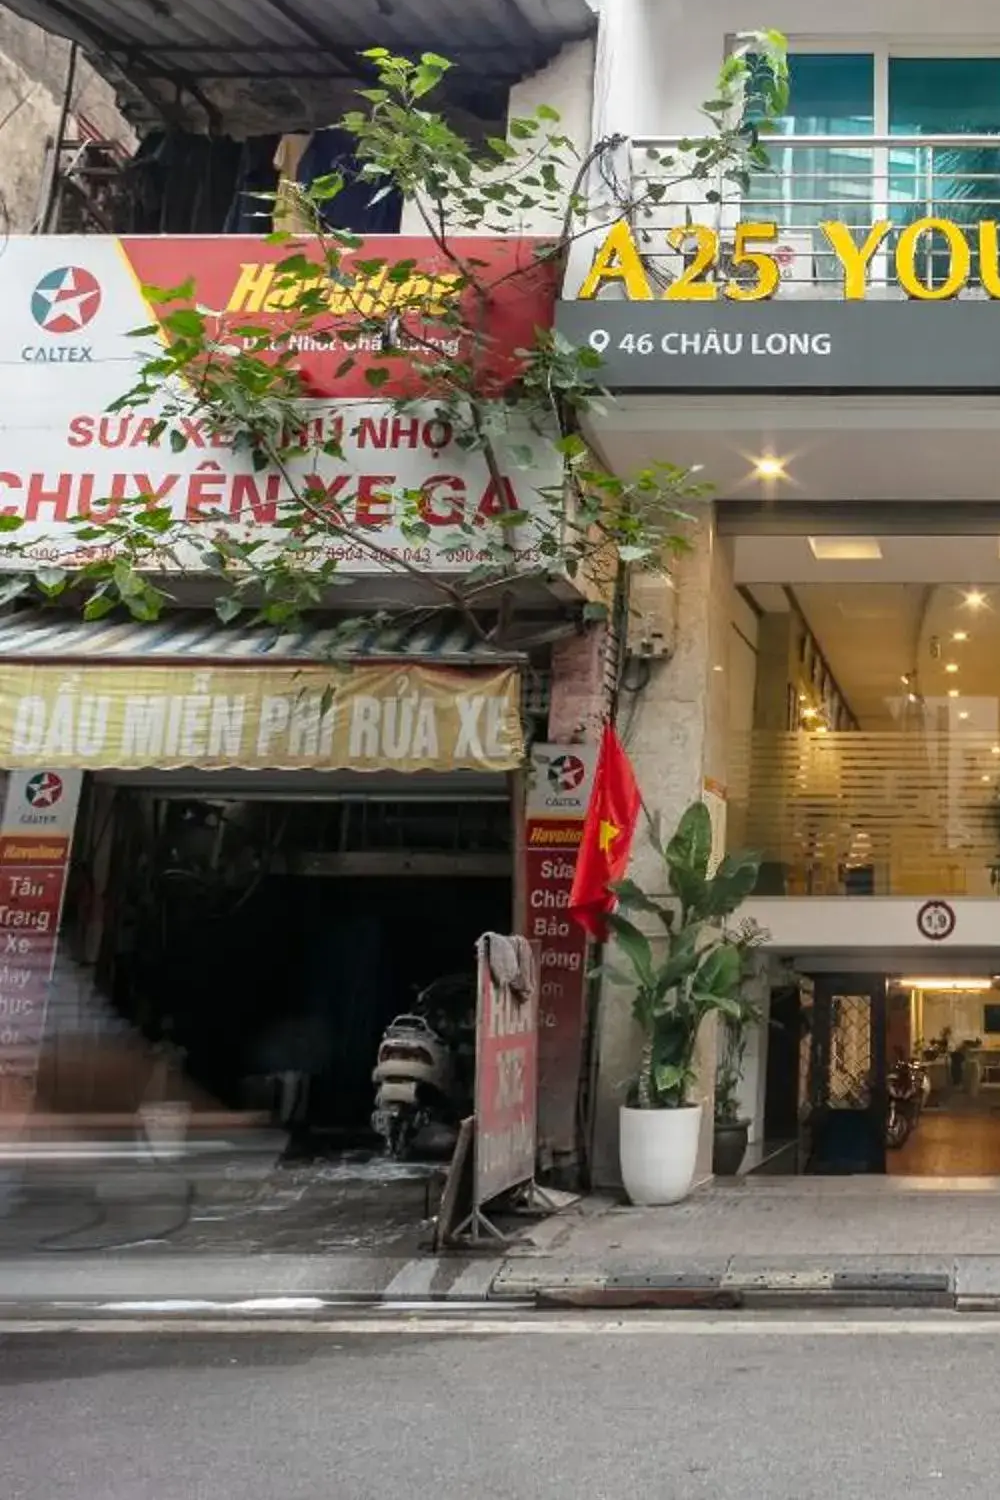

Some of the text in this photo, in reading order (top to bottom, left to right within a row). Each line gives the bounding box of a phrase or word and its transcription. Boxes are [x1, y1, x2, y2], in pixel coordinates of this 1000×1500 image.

[618, 327, 832, 355] 46 CHÂU LONG
[21, 345, 93, 363] CALTEX
[302, 474, 397, 526] XE
[416, 474, 521, 527] GA
[350, 674, 439, 759] RỬA
[453, 695, 512, 758] XE
[530, 826, 585, 844] Havolin
[533, 915, 570, 936] Bảo
